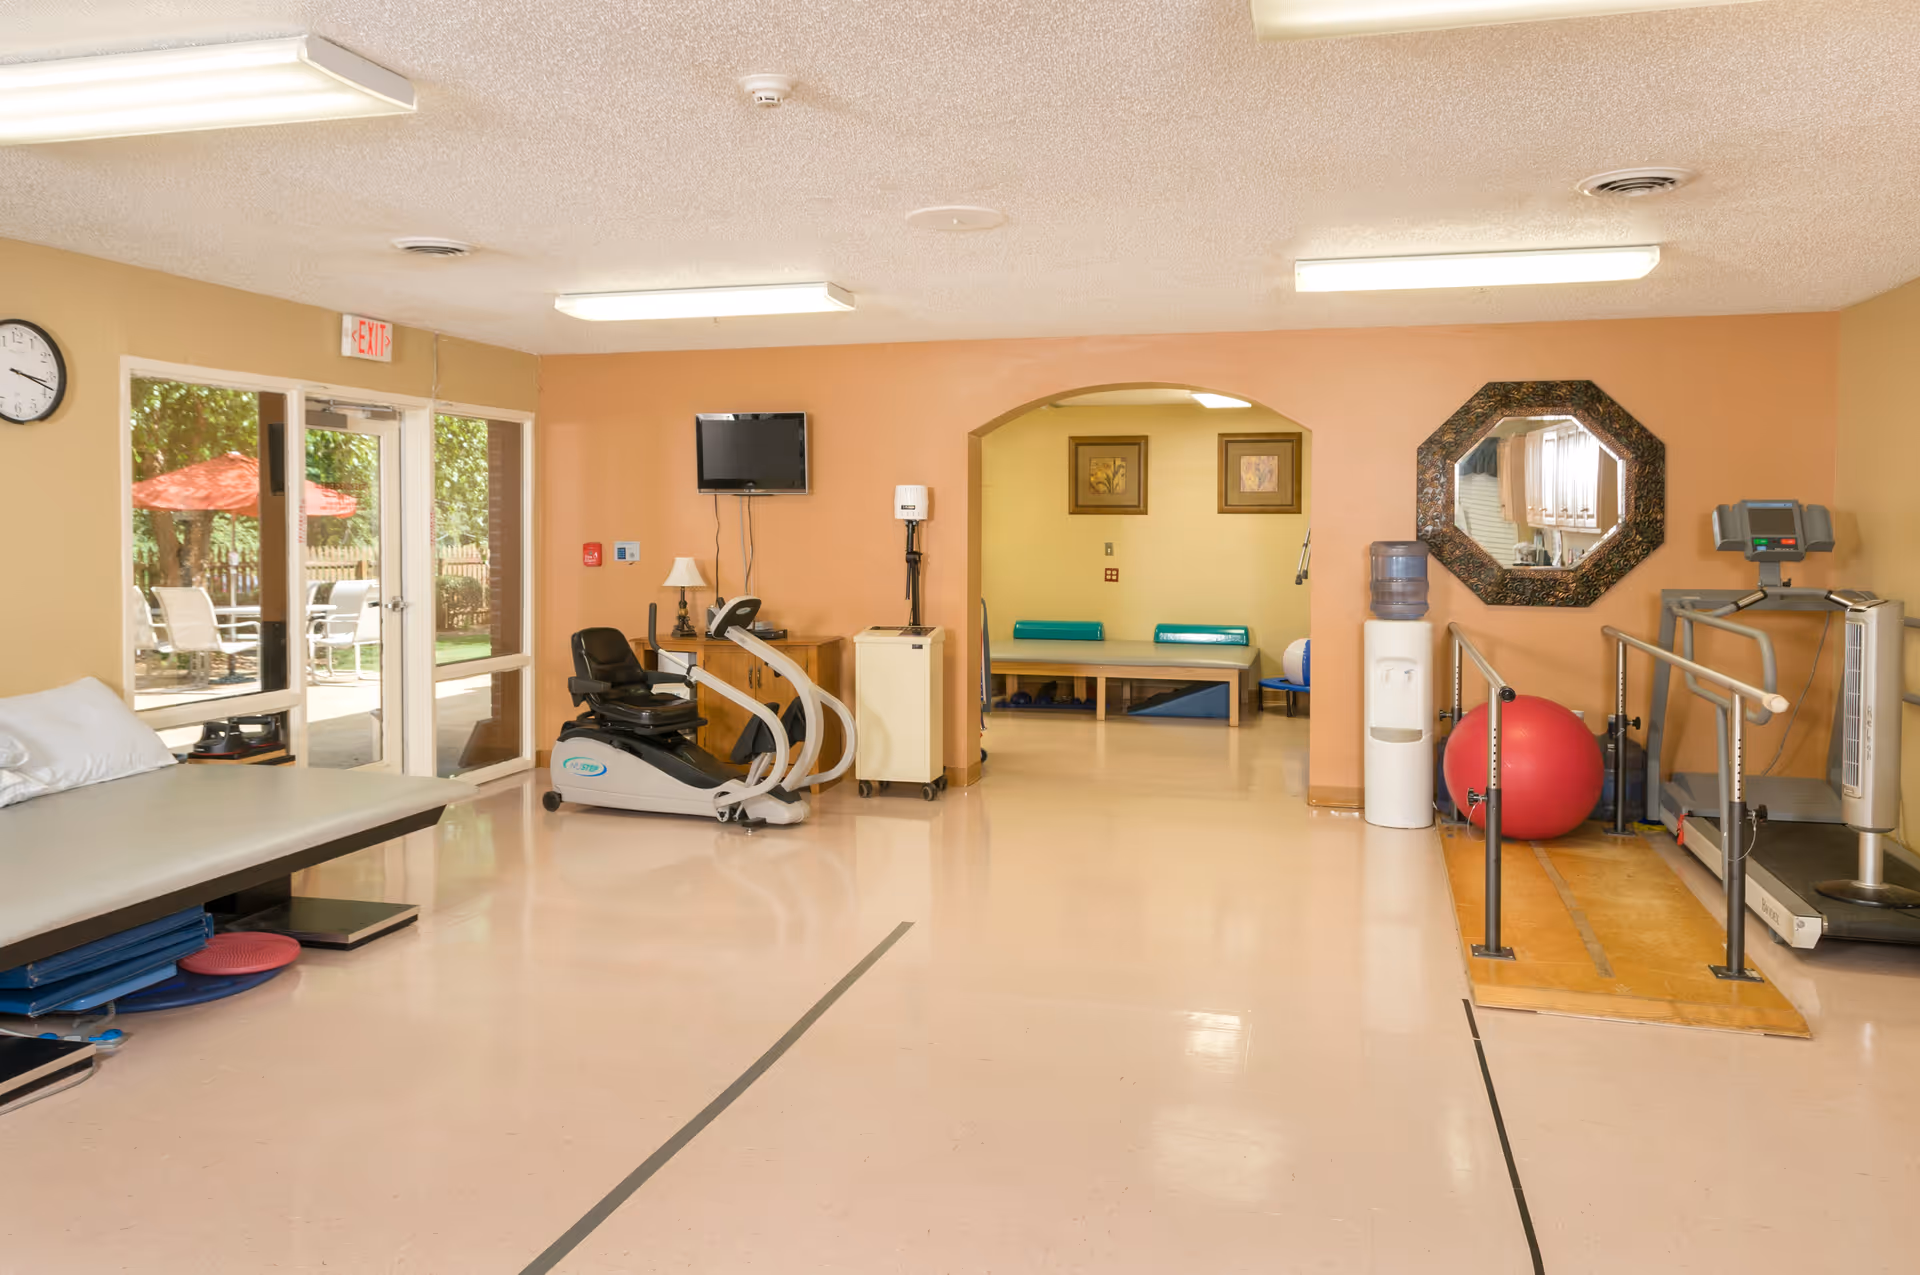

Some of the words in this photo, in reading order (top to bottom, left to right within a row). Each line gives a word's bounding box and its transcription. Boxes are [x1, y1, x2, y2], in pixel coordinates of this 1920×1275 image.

[12, 331, 23, 344] 12
[358, 320, 386, 356] EXIT
[30, 339, 34, 350] 1
[40, 351, 48, 363] 2
[14, 402, 22, 413] 6
[30, 398, 37, 409] 5
